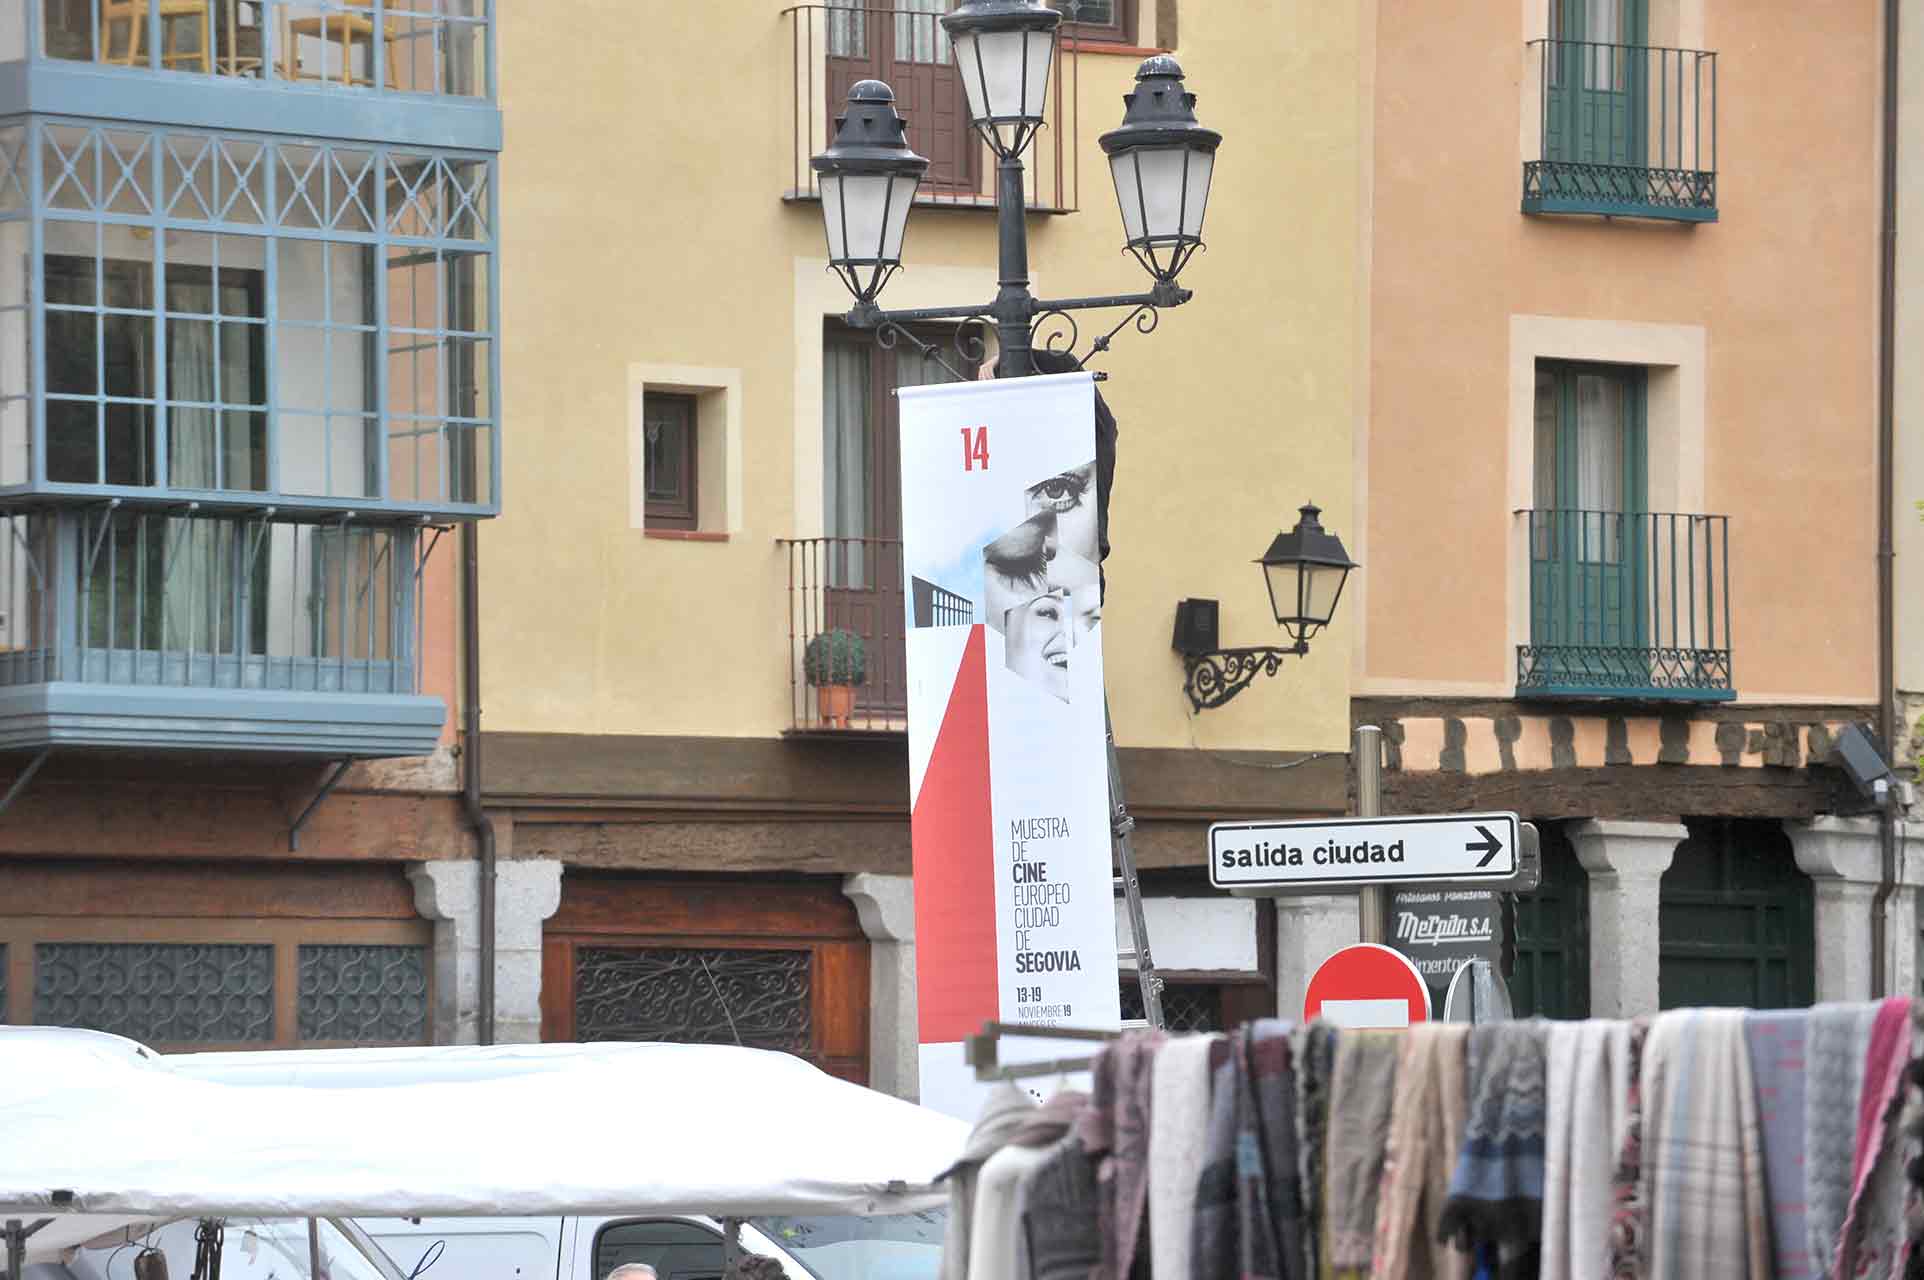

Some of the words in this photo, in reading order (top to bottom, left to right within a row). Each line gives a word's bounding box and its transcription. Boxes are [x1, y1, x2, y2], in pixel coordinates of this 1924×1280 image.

[960, 426, 990, 471] 14
[1011, 817, 1070, 841] MUESTRA
[1012, 840, 1029, 862] DE
[1221, 841, 1304, 868] salida
[1312, 839, 1405, 865] ciudad
[1013, 862, 1047, 884] CINE
[1014, 883, 1071, 906] EUROPEO
[1014, 906, 1060, 929] CIUDAD
[1015, 929, 1031, 951] DE
[1015, 950, 1081, 974] SEGOVIA
[1017, 1004, 1063, 1019] NOVIEMBRE
[1063, 1004, 1072, 1017] 19
